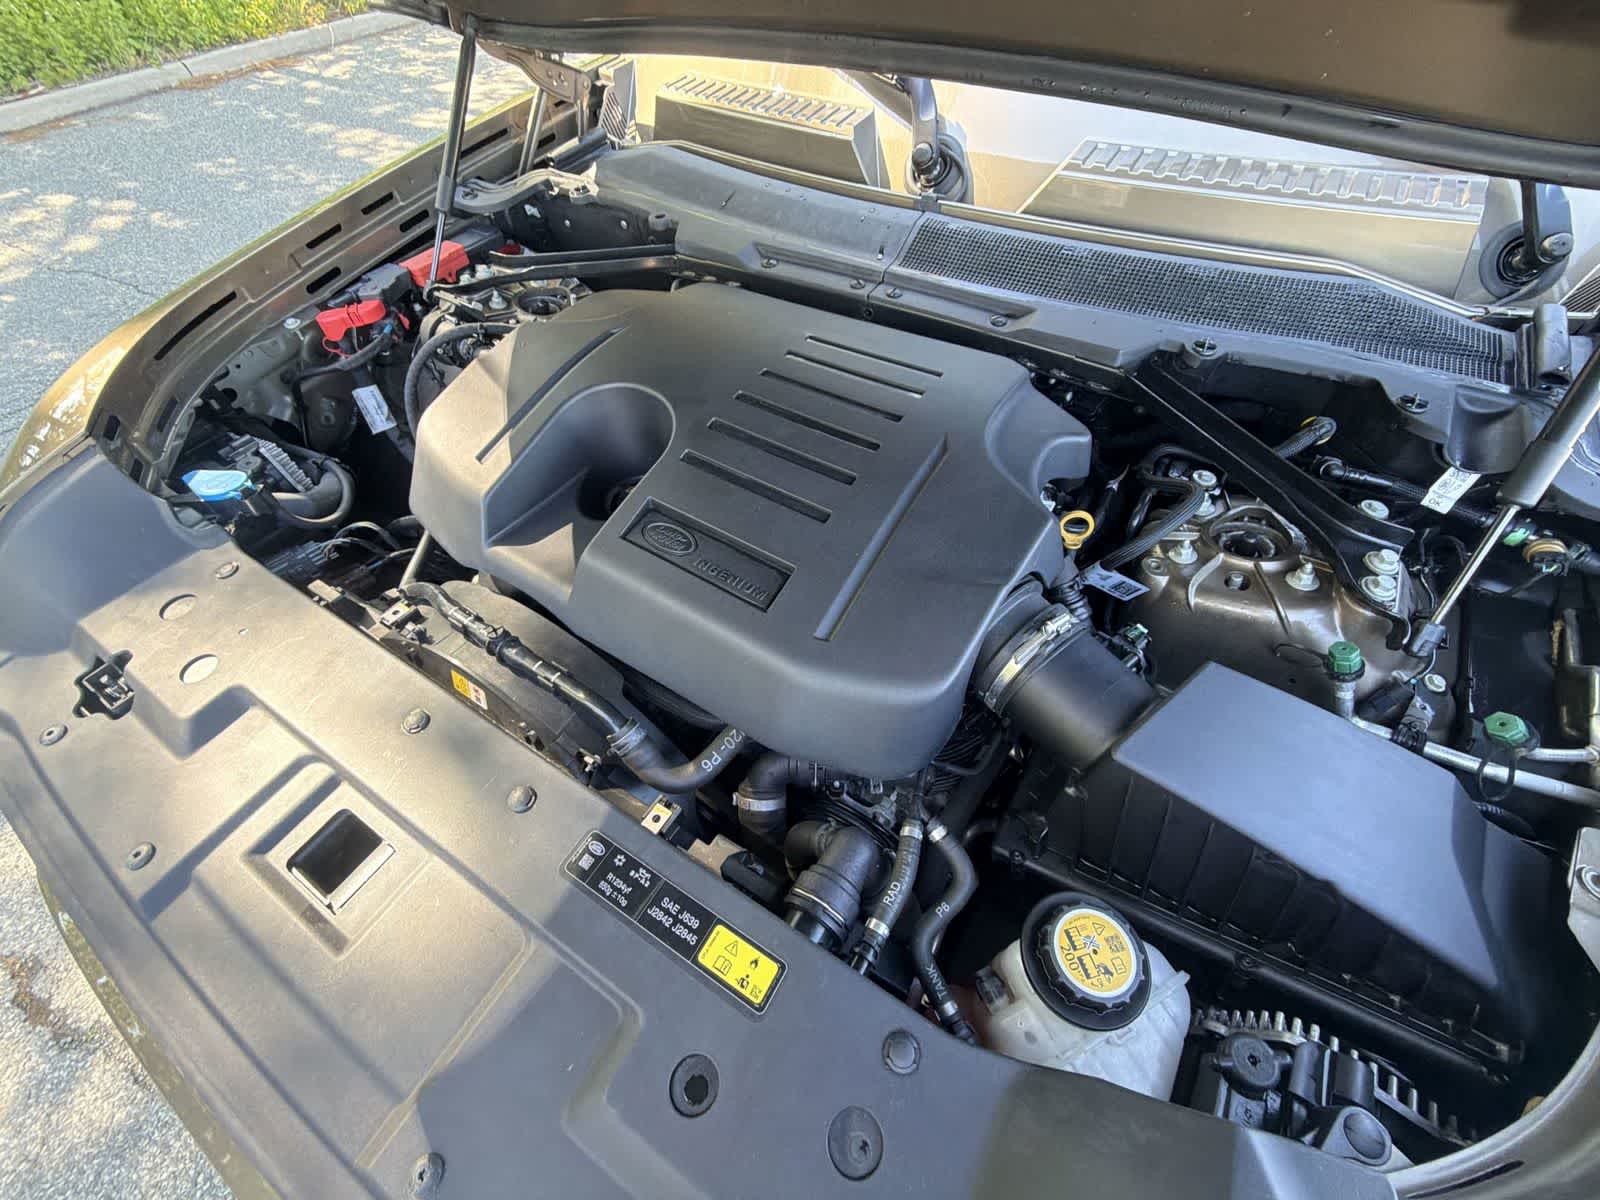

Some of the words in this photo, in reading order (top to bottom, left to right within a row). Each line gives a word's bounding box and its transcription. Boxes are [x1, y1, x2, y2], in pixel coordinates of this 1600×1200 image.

[693, 558, 769, 601] INGENIUM
[701, 751, 722, 772] P6
[606, 872, 633, 895] R1234yf
[883, 881, 900, 906] RAD
[647, 905, 673, 928] J2842
[671, 922, 699, 946] J2845
[660, 896, 681, 915] SAE
[678, 909, 700, 930] J639
[926, 963, 948, 1001] TANK
